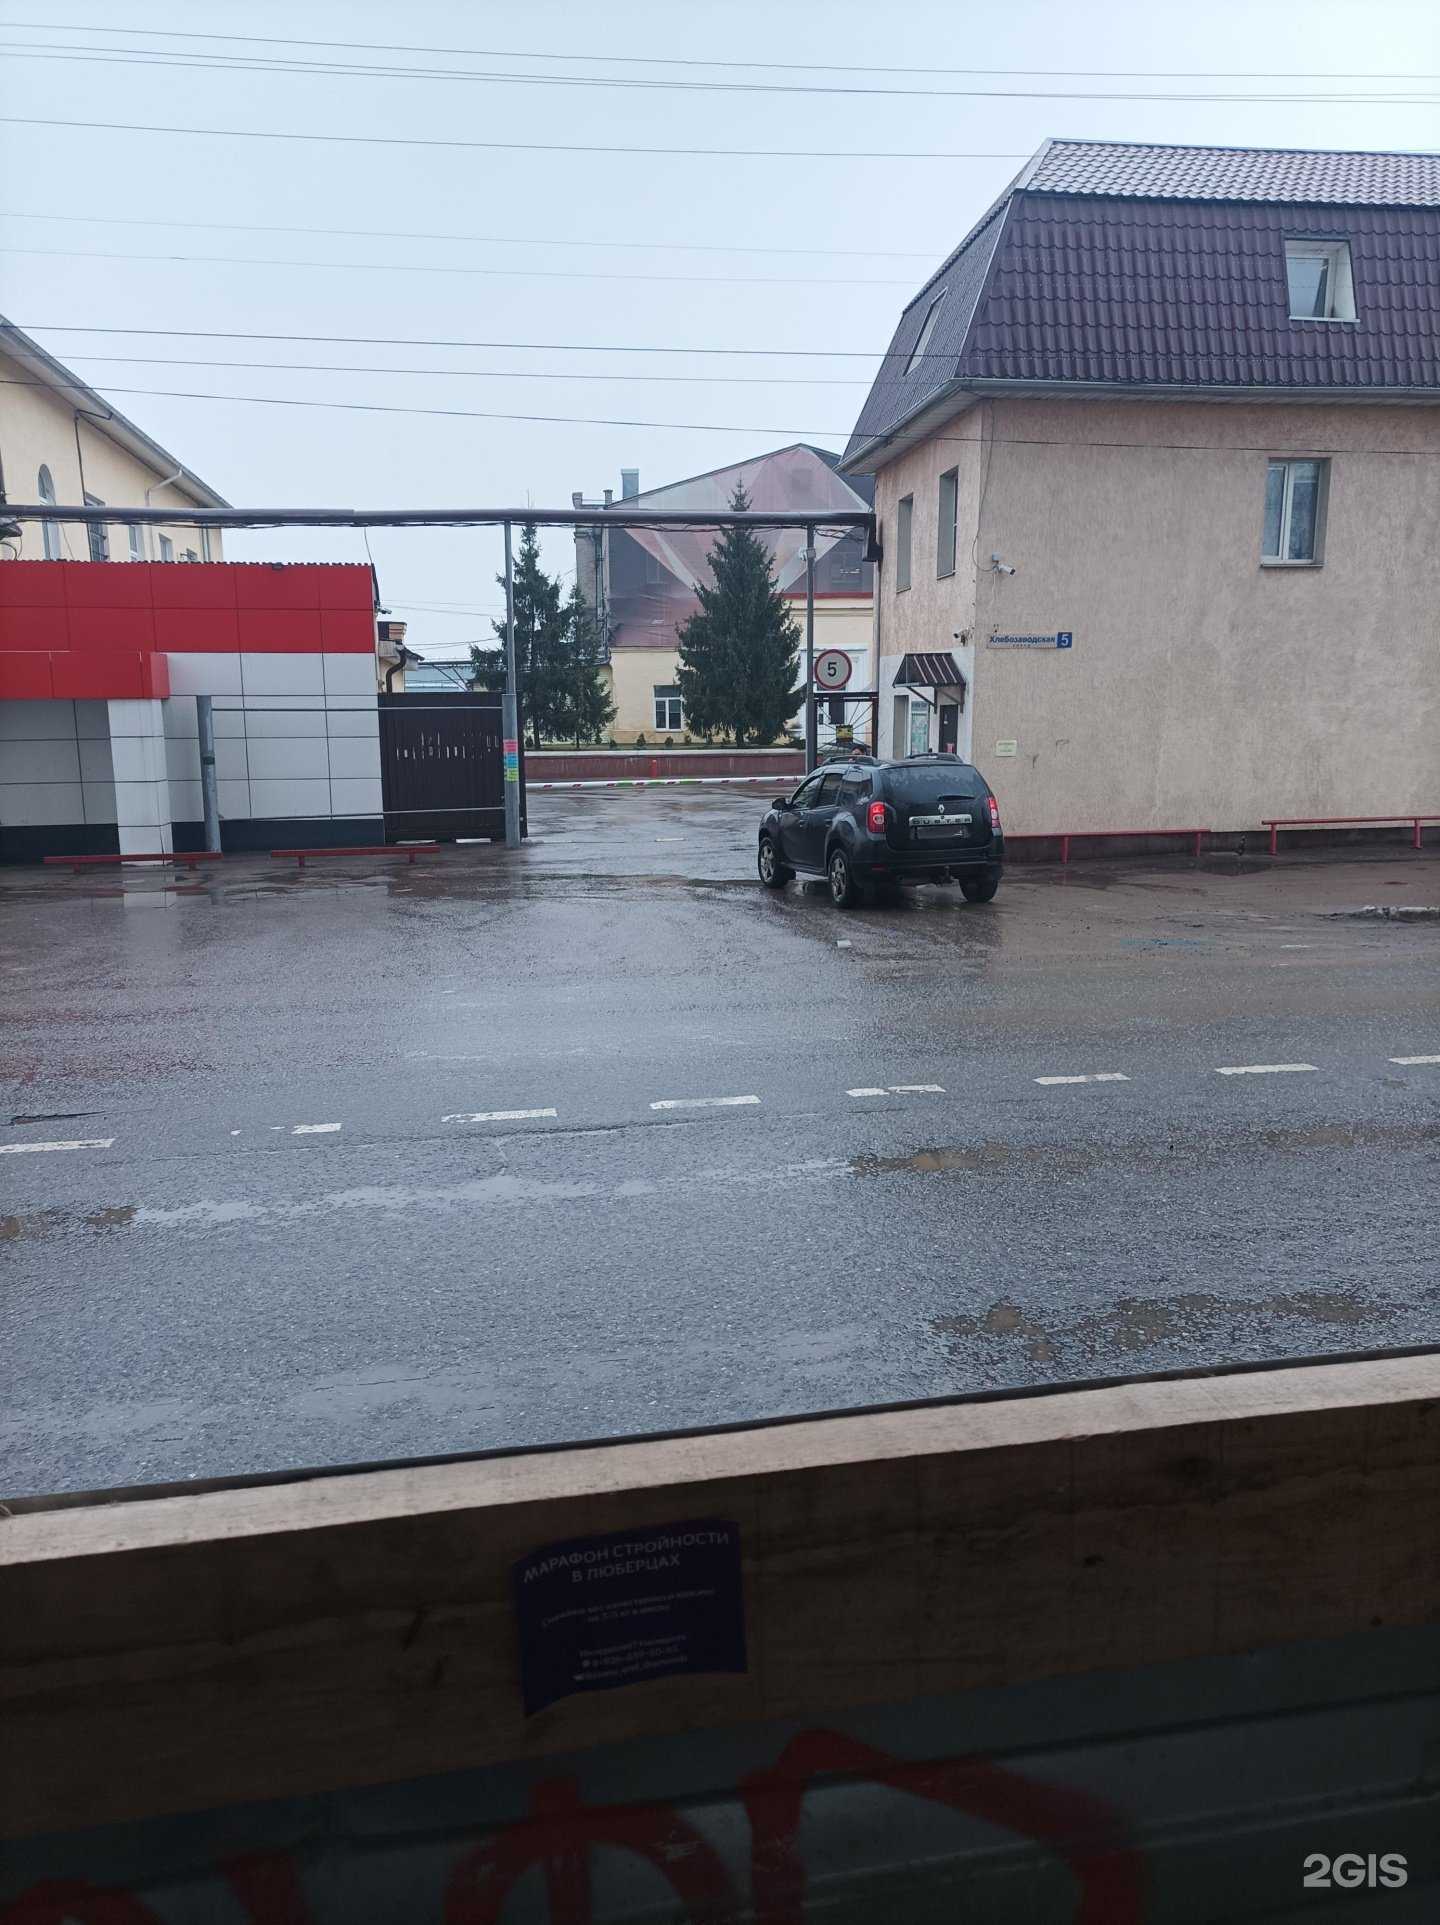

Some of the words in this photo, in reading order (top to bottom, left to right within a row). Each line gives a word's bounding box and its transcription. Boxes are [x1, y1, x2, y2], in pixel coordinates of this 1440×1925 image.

[990, 635, 1056, 645] Хлебозаводская
[1060, 633, 1070, 647] 5
[827, 661, 837, 678] 5
[523, 1548, 609, 1583] МАРАФОН
[612, 1531, 730, 1558] СТРОЙНОСТИ
[572, 1569, 583, 1583] В
[586, 1553, 681, 1580] ЛЮБЕРЦАХ
